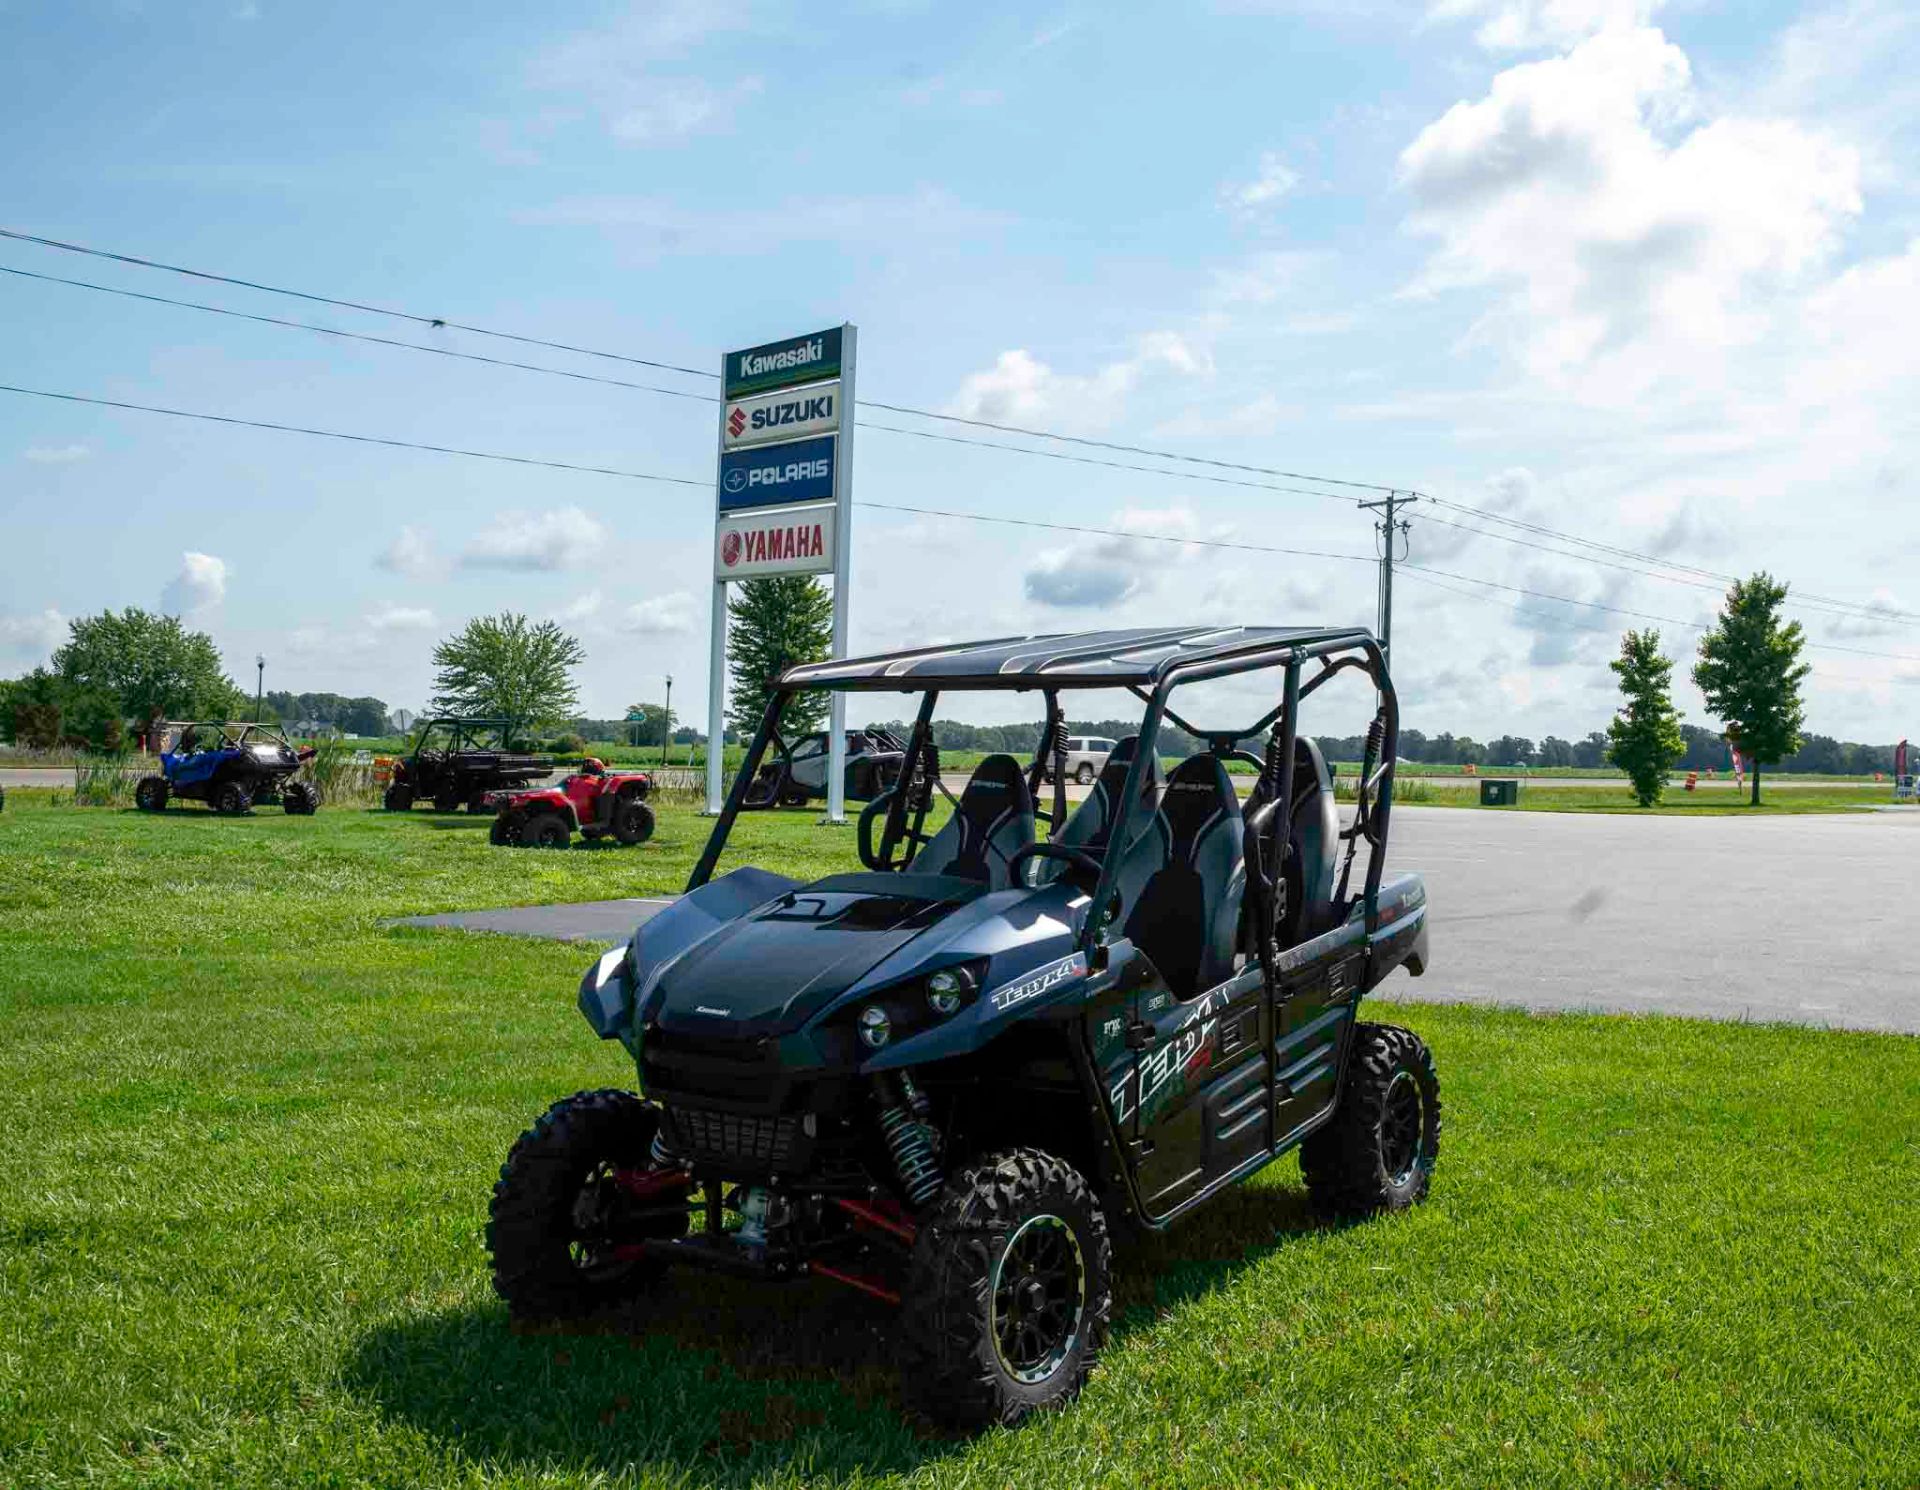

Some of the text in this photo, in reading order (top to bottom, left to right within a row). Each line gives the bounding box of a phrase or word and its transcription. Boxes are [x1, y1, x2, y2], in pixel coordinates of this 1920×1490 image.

[740, 338, 823, 378] Kawasaki
[751, 395, 833, 430] SUZUKI
[749, 459, 828, 488] POLARIS
[744, 524, 823, 562] YAMAHA
